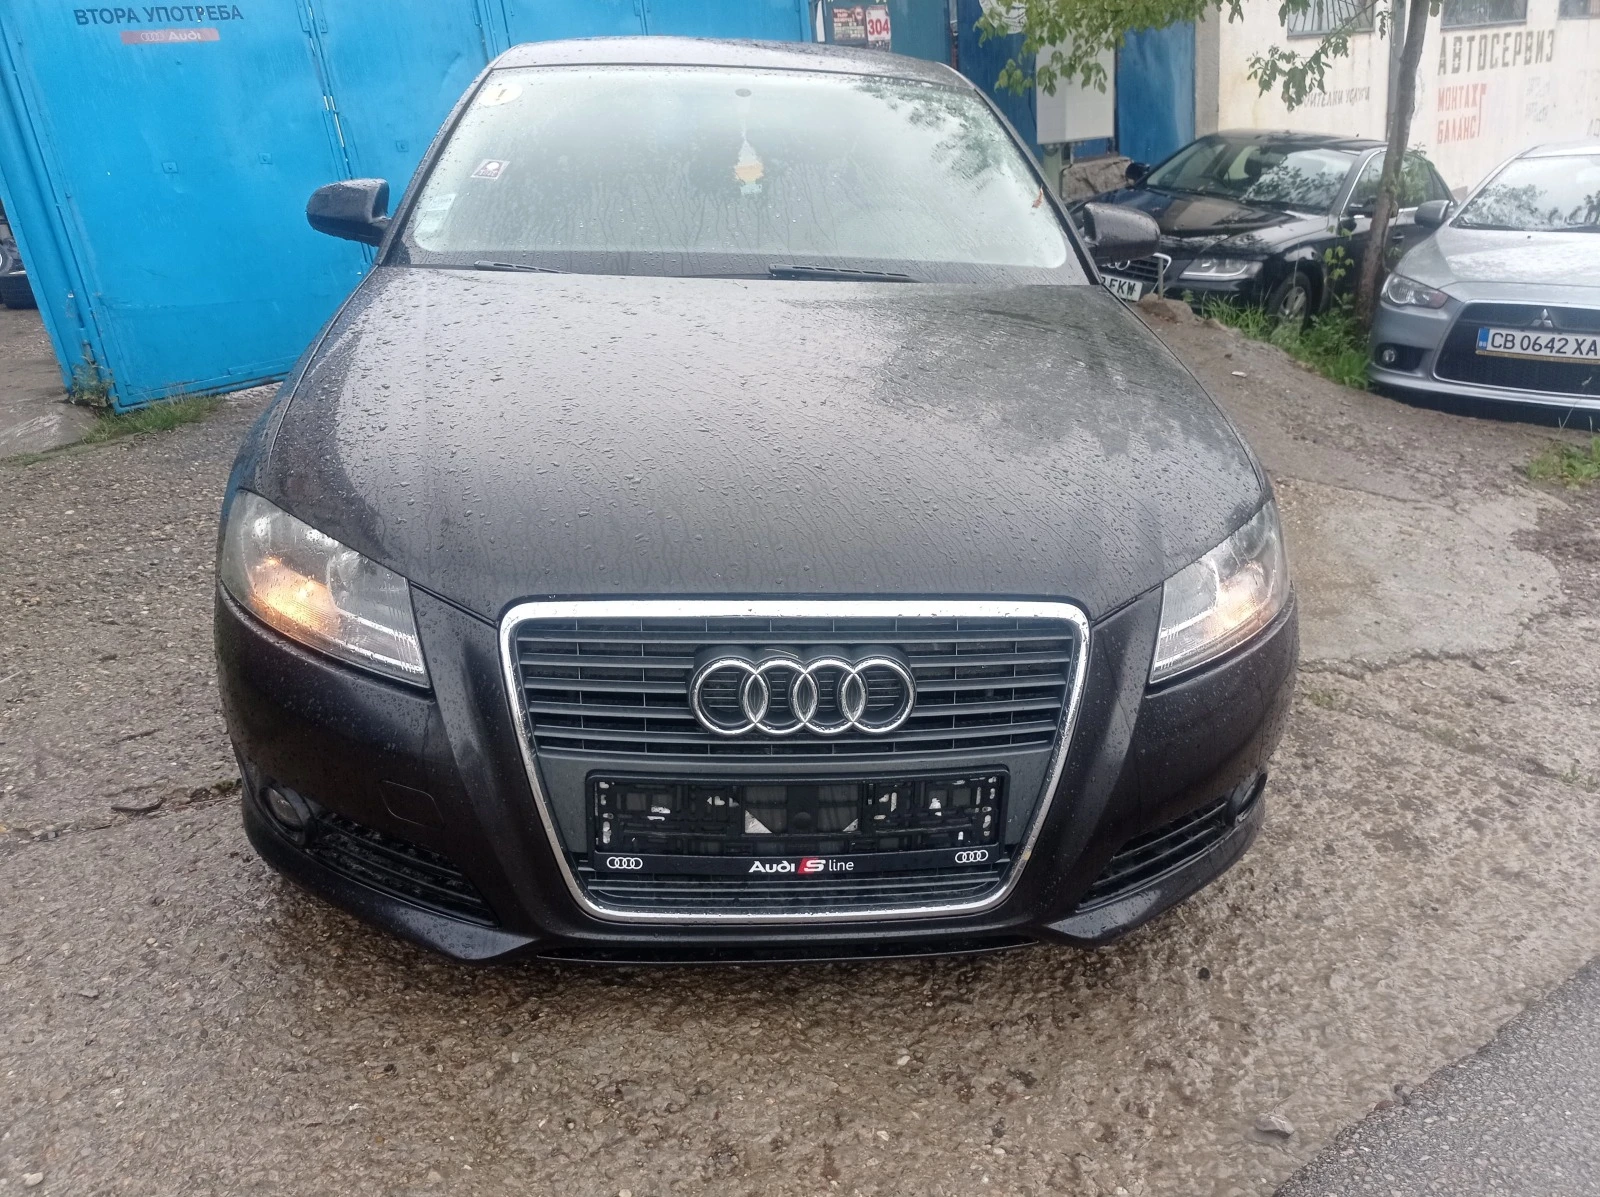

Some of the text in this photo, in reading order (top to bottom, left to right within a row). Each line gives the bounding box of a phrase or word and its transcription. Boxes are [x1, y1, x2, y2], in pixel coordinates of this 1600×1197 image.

[73, 5, 244, 25] ВТОРА УПОТРЕБА
[168, 30, 202, 41] Audi
[867, 18, 890, 36] 304
[1437, 29, 1555, 76] АВТОСЕРВИЗ
[1437, 83, 1479, 112] МОНТАЖ
[1436, 115, 1477, 145] БАЛАНС
[1520, 334, 1569, 355] 0642
[748, 860, 796, 873] Audi
[829, 859, 855, 871] line
